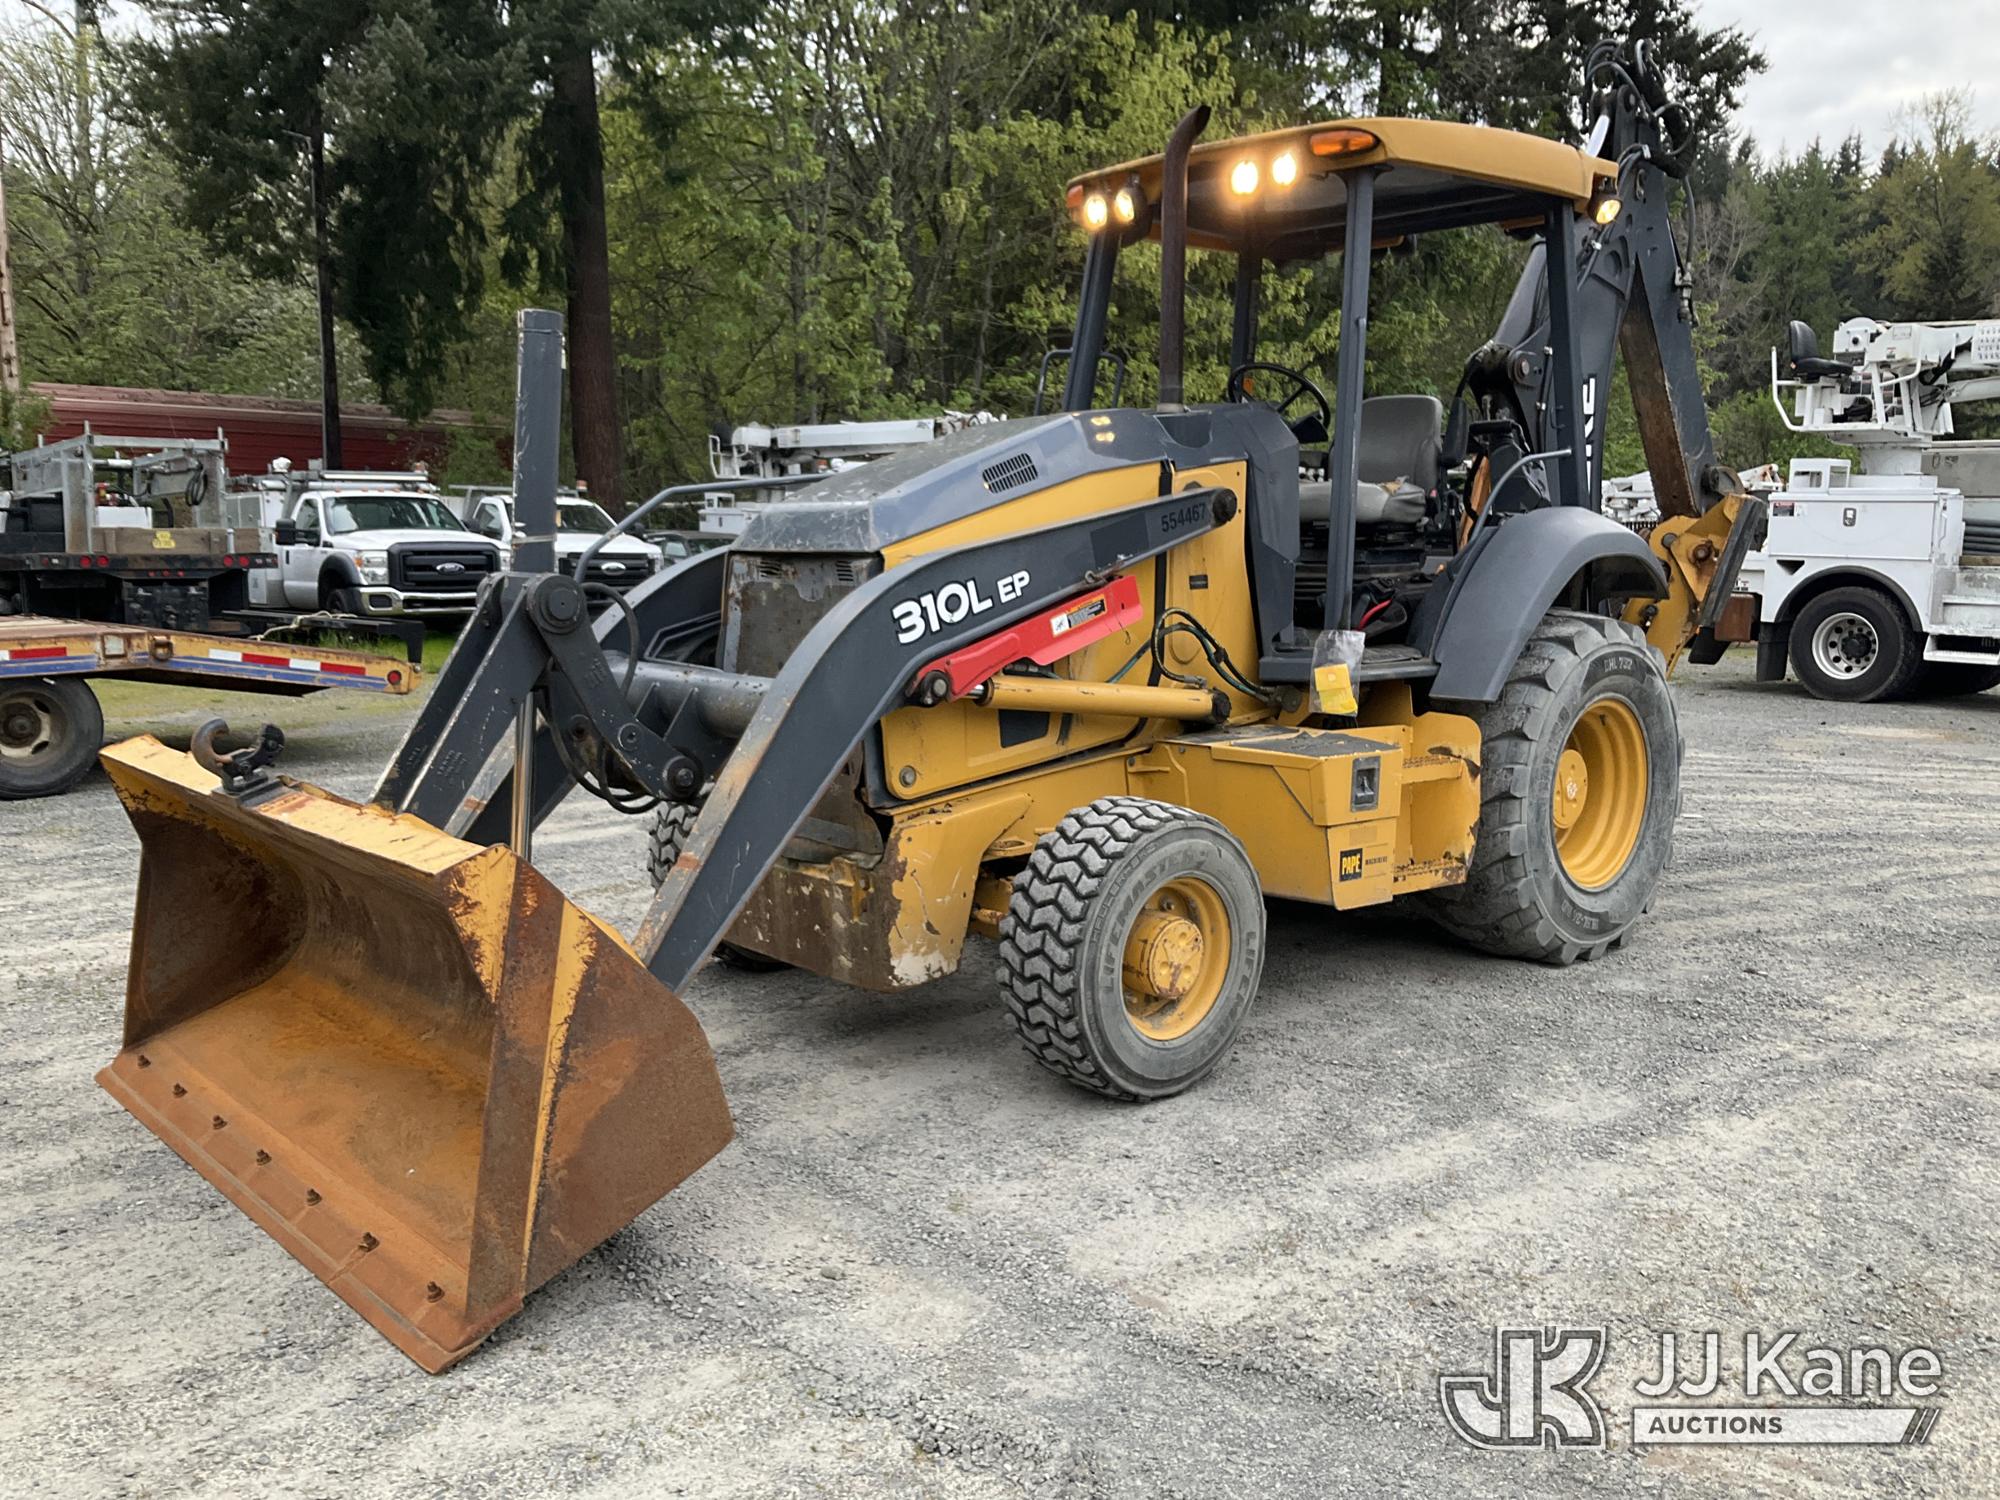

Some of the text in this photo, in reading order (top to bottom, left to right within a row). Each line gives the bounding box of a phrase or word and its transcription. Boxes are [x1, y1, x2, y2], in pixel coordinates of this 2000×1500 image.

[1161, 502, 1206, 532] 554467
[892, 570, 1030, 644] 310L EP
